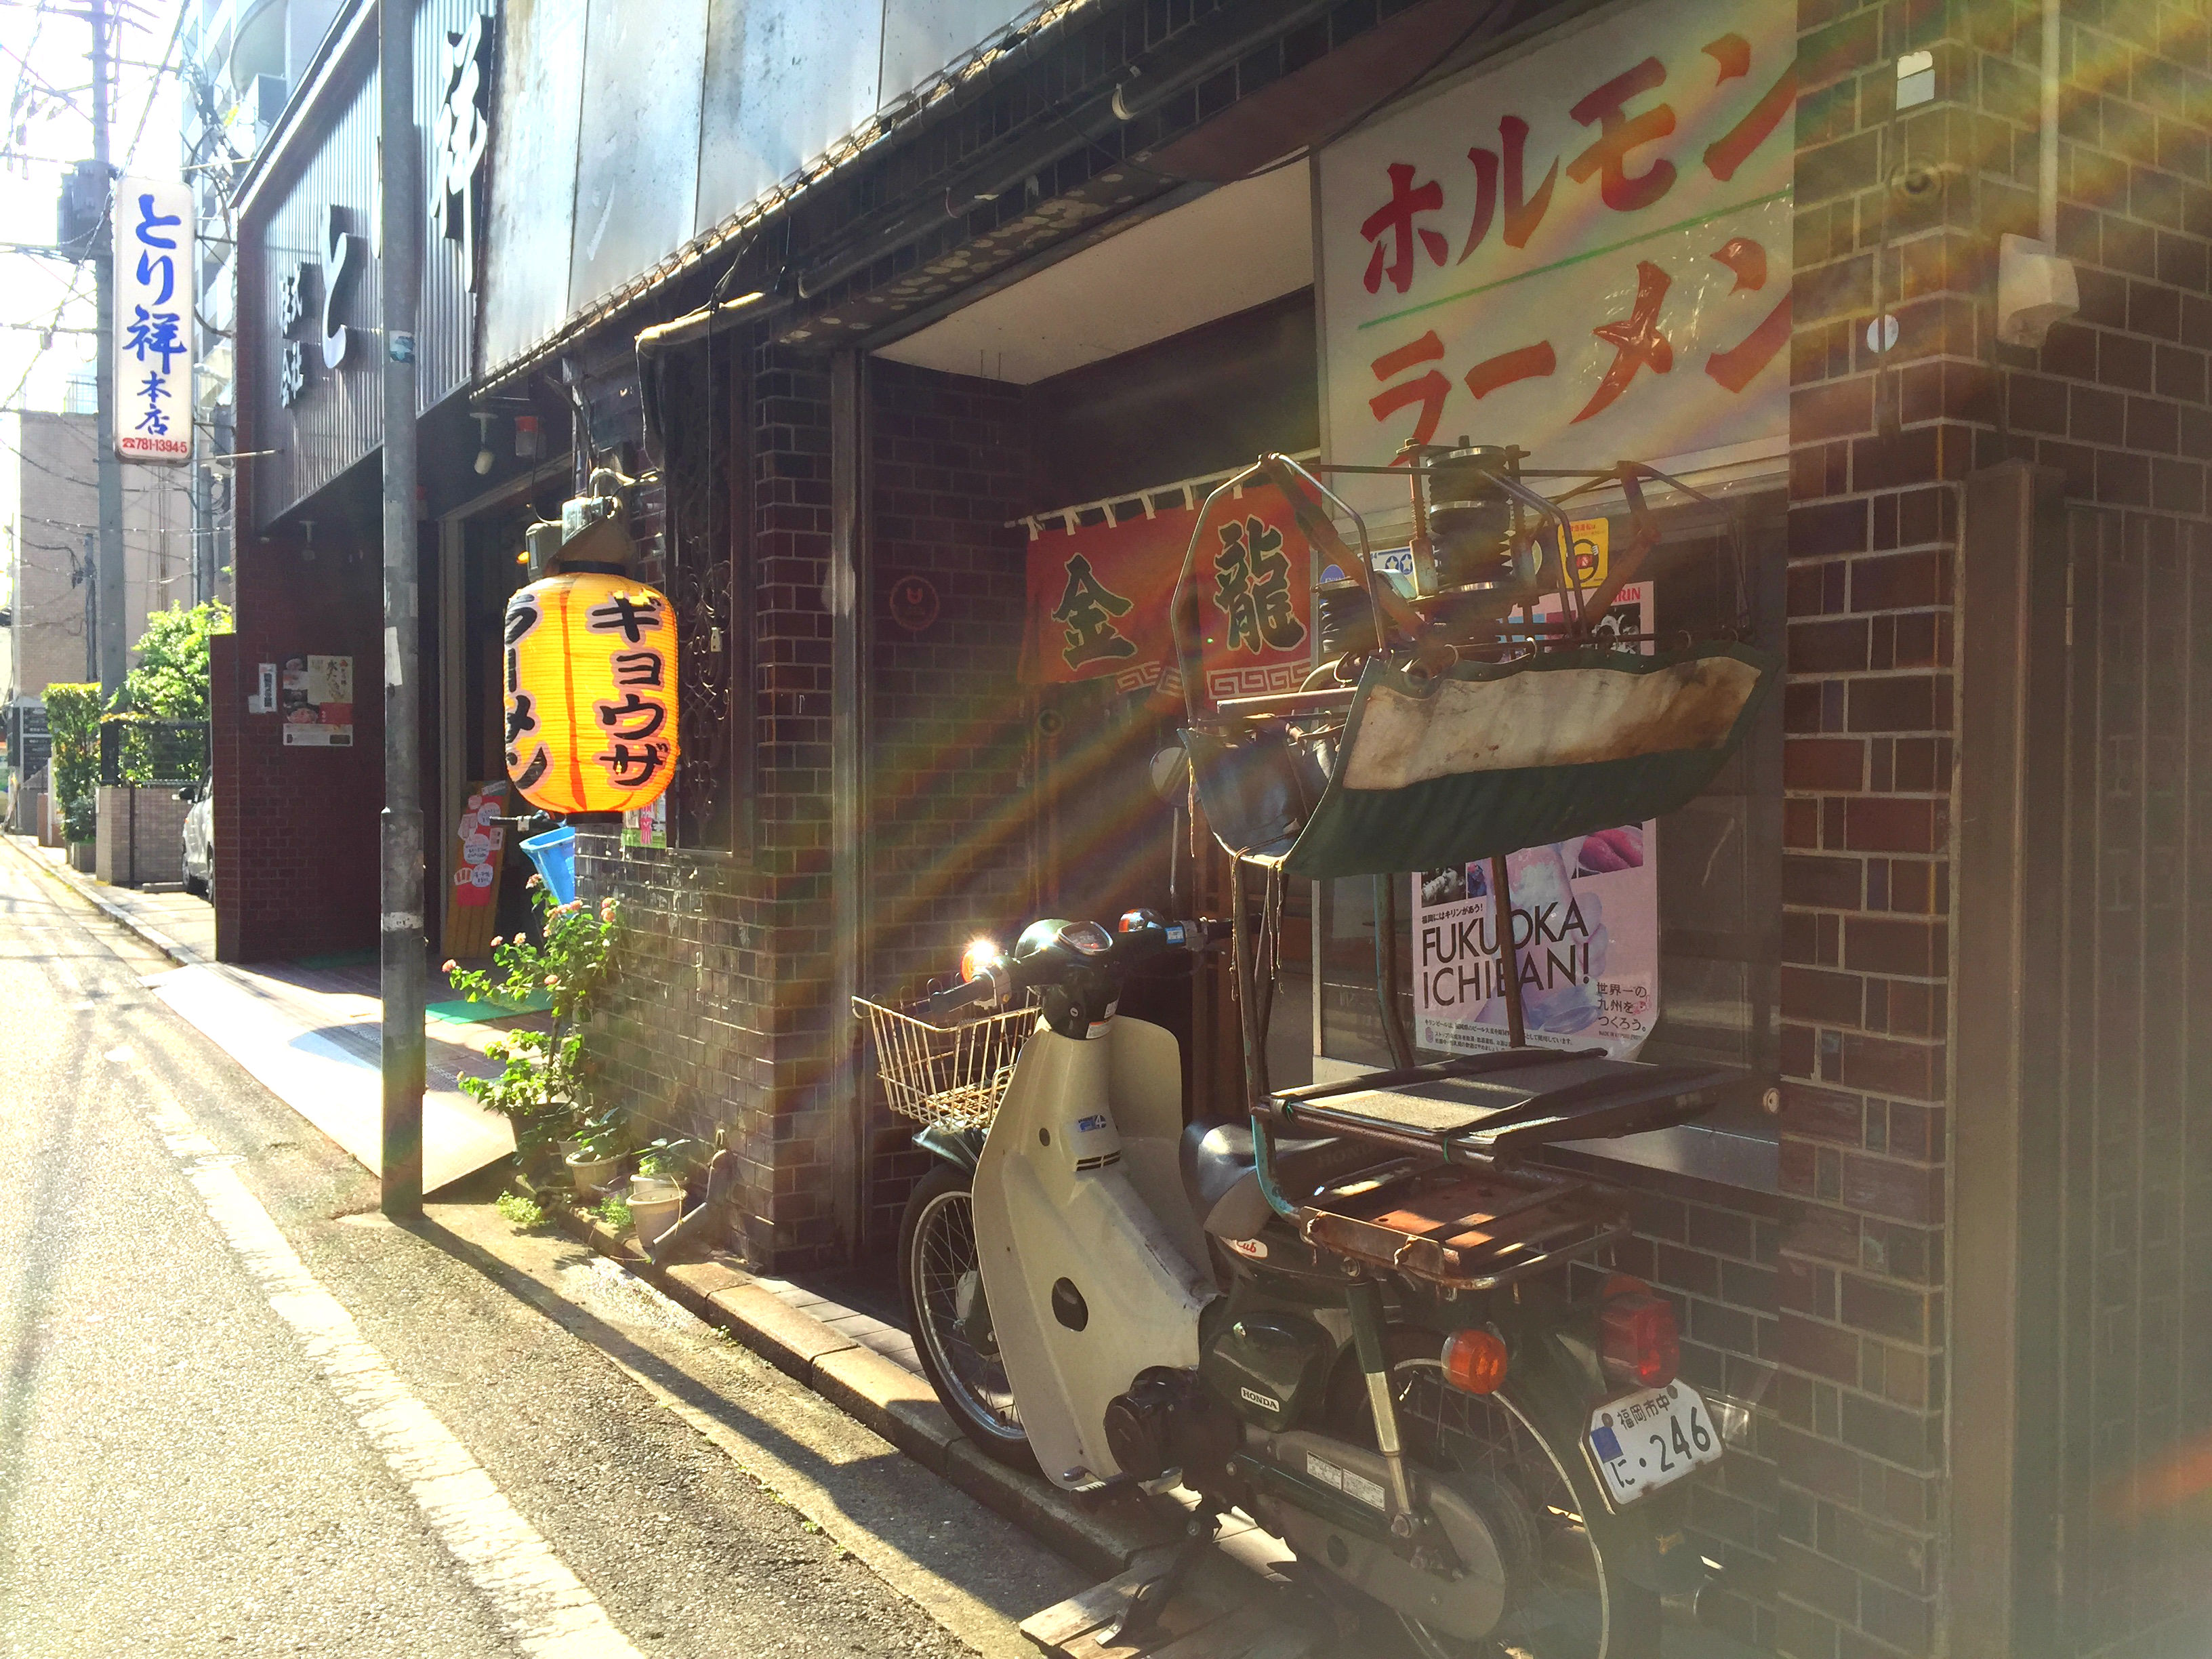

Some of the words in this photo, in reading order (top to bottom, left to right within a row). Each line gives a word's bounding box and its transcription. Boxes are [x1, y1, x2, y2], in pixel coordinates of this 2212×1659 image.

[1360, 33, 1797, 293] ホルモン
[1369, 237, 1793, 467] ラーメン
[505, 594, 547, 790] ラーメン
[1422, 897, 1589, 966] FUKUOKA
[1597, 982, 1647, 998] 世界一の
[1597, 998, 1634, 1014] 九州を
[1598, 1017, 1646, 1032] つくろう。
[1242, 1389, 1278, 1410] HONDA
[1617, 1393, 1671, 1430] 福岡市中
